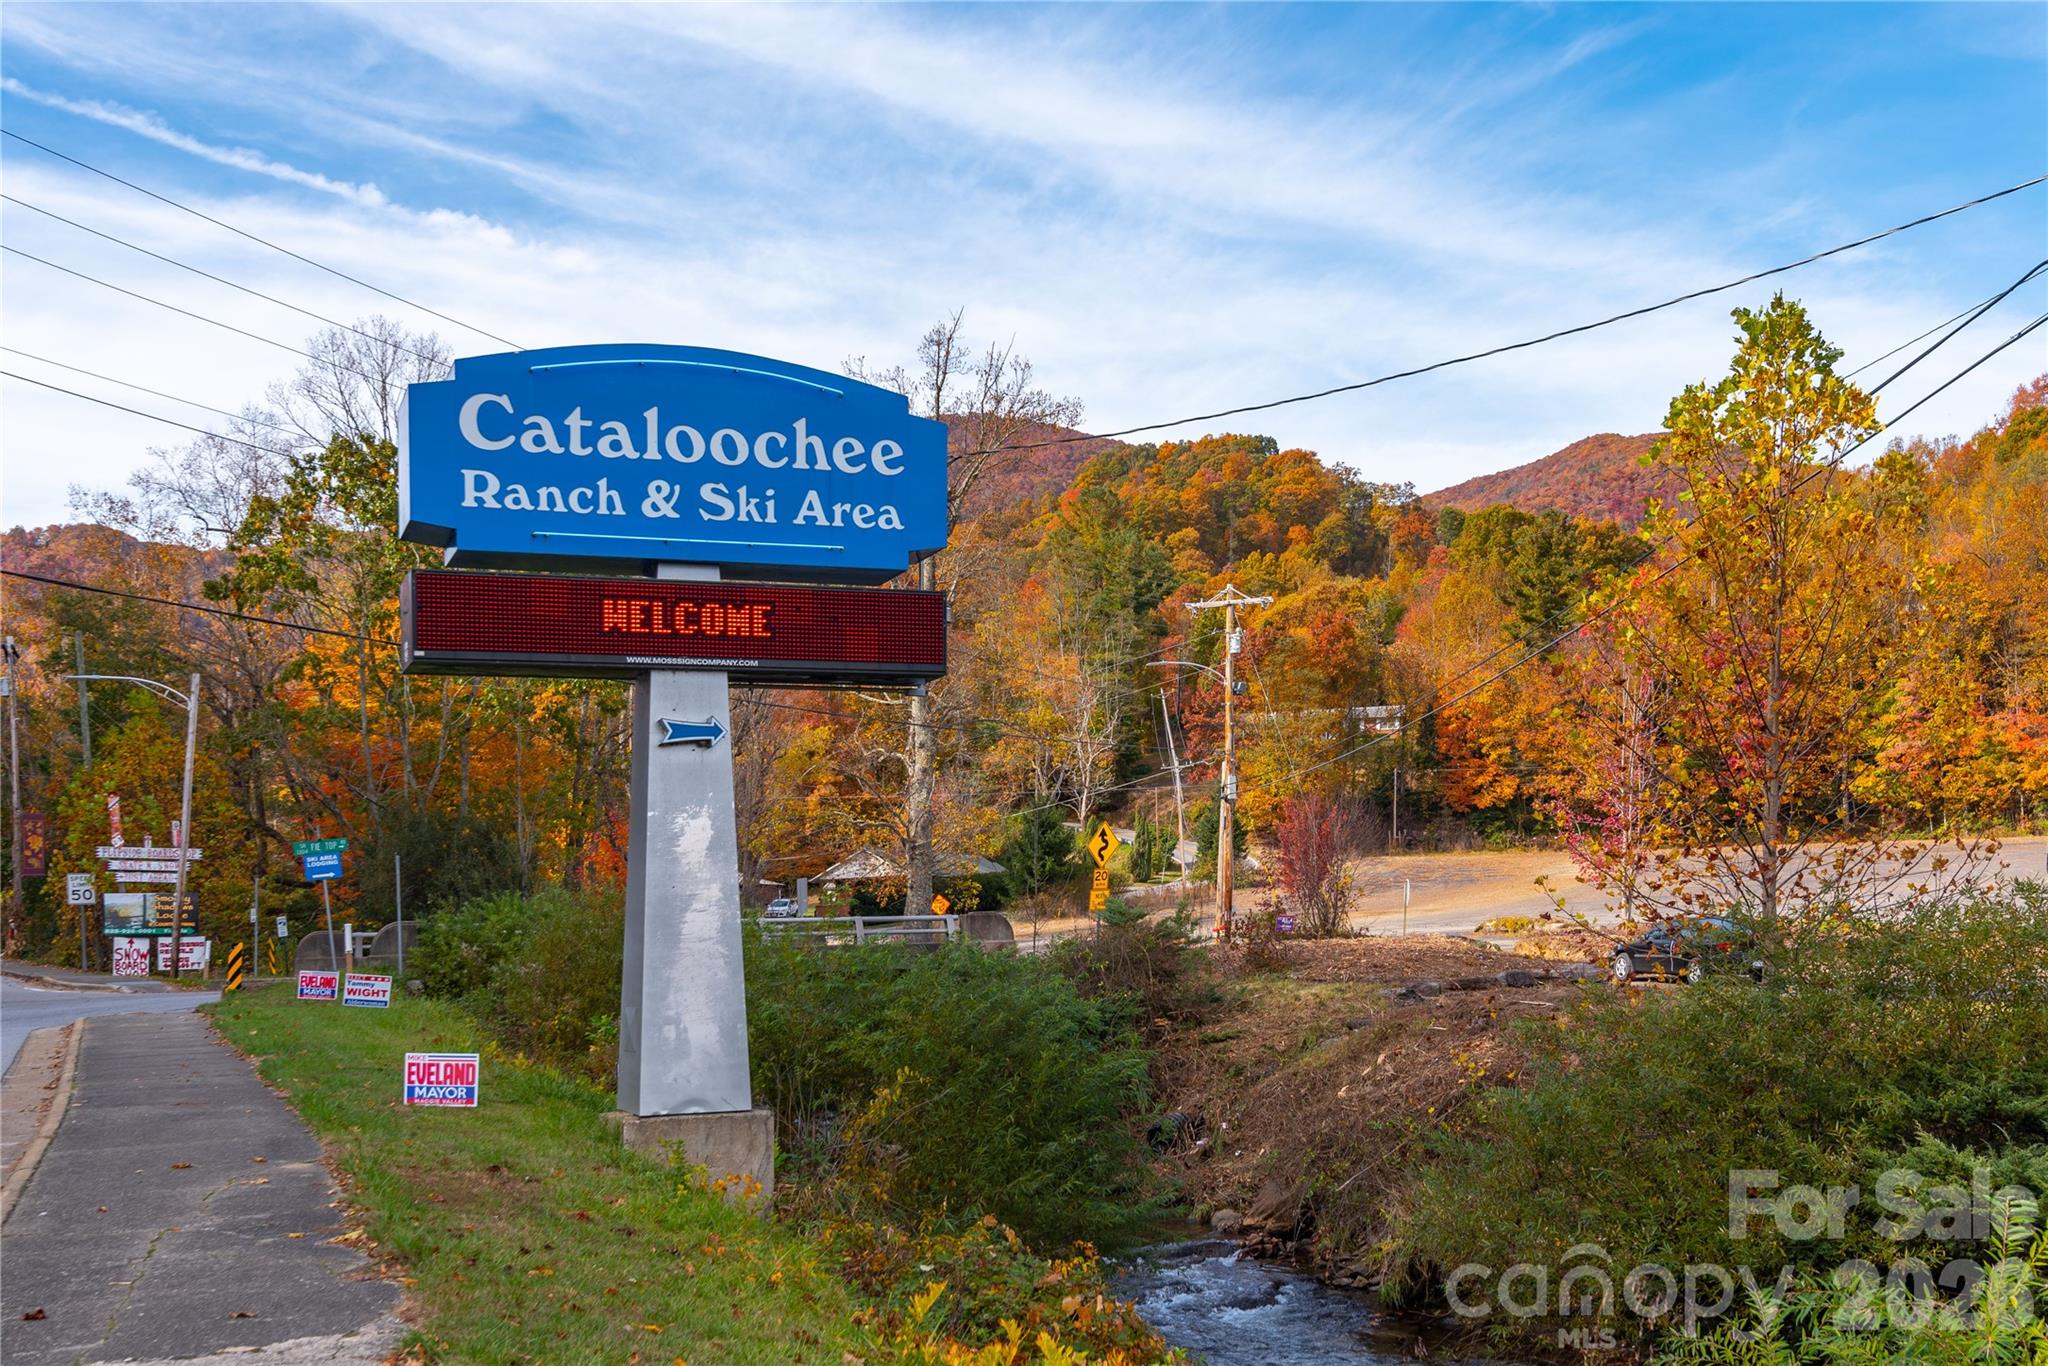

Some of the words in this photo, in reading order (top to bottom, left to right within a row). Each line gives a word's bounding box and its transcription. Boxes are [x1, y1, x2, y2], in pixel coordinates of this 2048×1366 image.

[458, 393, 905, 476] Cataloochee
[460, 469, 626, 516] Ranch
[641, 480, 680, 519] &
[698, 482, 777, 523] Ski
[793, 490, 904, 530] Area
[603, 600, 771, 636] WELCOME
[626, 656, 759, 667] WWW.MOSSSIGNCOMPANY.COM
[324, 841, 337, 849] TOP
[147, 849, 198, 859] BOARDSOP
[1095, 871, 1108, 881] 20
[71, 889, 93, 901] 50
[154, 895, 191, 904] Smoy
[114, 948, 149, 961] SNOW
[114, 961, 147, 971] BOARD
[300, 976, 337, 988] EVELAND
[347, 980, 375, 988] Tammy
[347, 988, 388, 998] WIGHT
[407, 1062, 476, 1085] EVELAND
[414, 1086, 467, 1099] MAYOR
